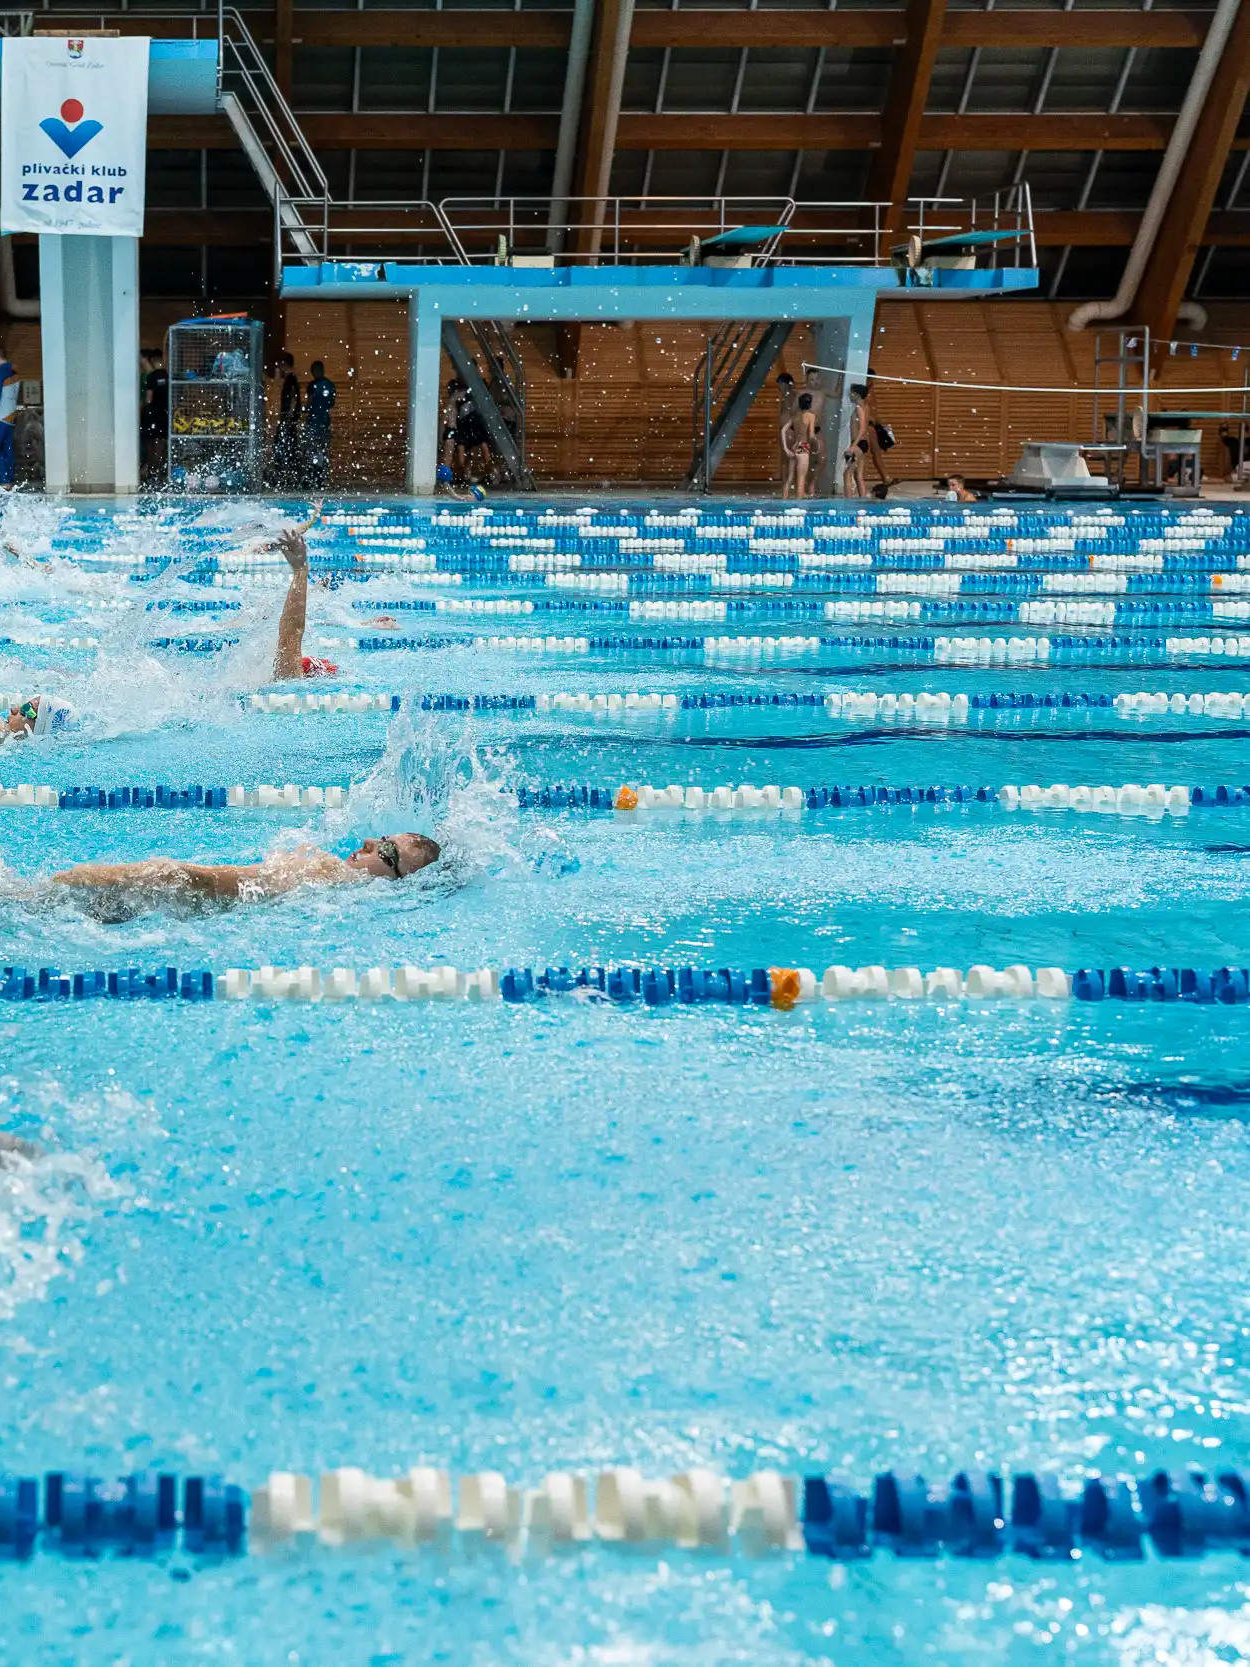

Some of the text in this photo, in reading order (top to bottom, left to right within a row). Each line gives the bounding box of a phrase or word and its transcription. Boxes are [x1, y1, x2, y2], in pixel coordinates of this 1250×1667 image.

[22, 163, 127, 177] plivački klub
[22, 180, 125, 204] zadar
